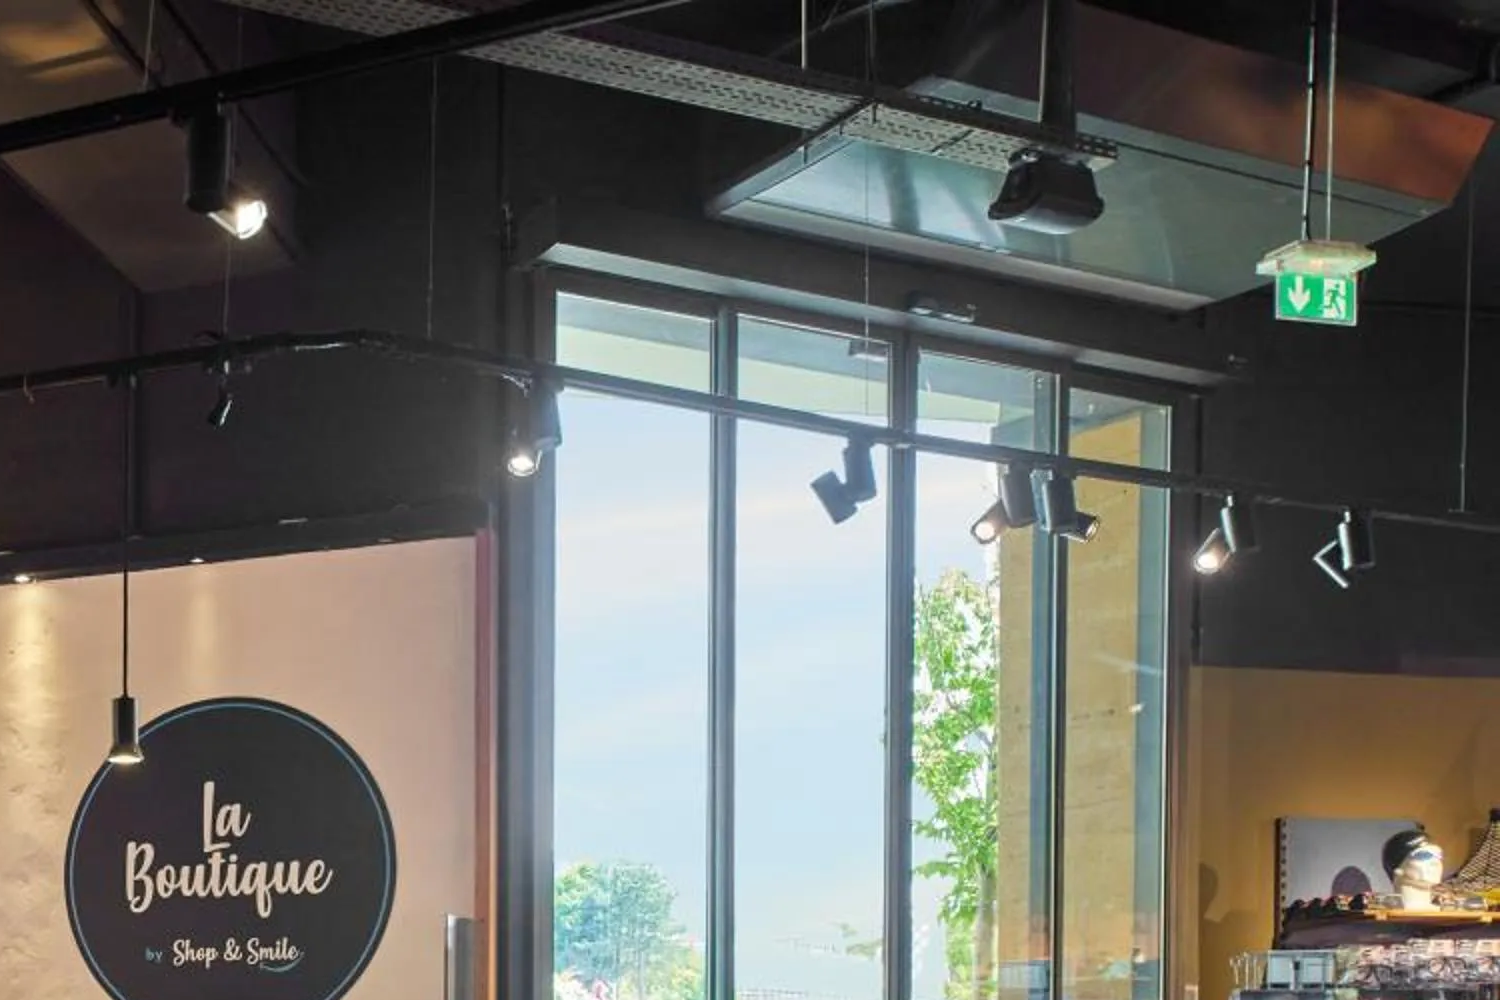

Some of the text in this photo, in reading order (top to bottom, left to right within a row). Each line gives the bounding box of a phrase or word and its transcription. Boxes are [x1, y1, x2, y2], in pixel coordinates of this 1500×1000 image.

[203, 781, 251, 853] La
[126, 840, 333, 918] Boutique
[145, 937, 302, 969] by Shop & Smile
